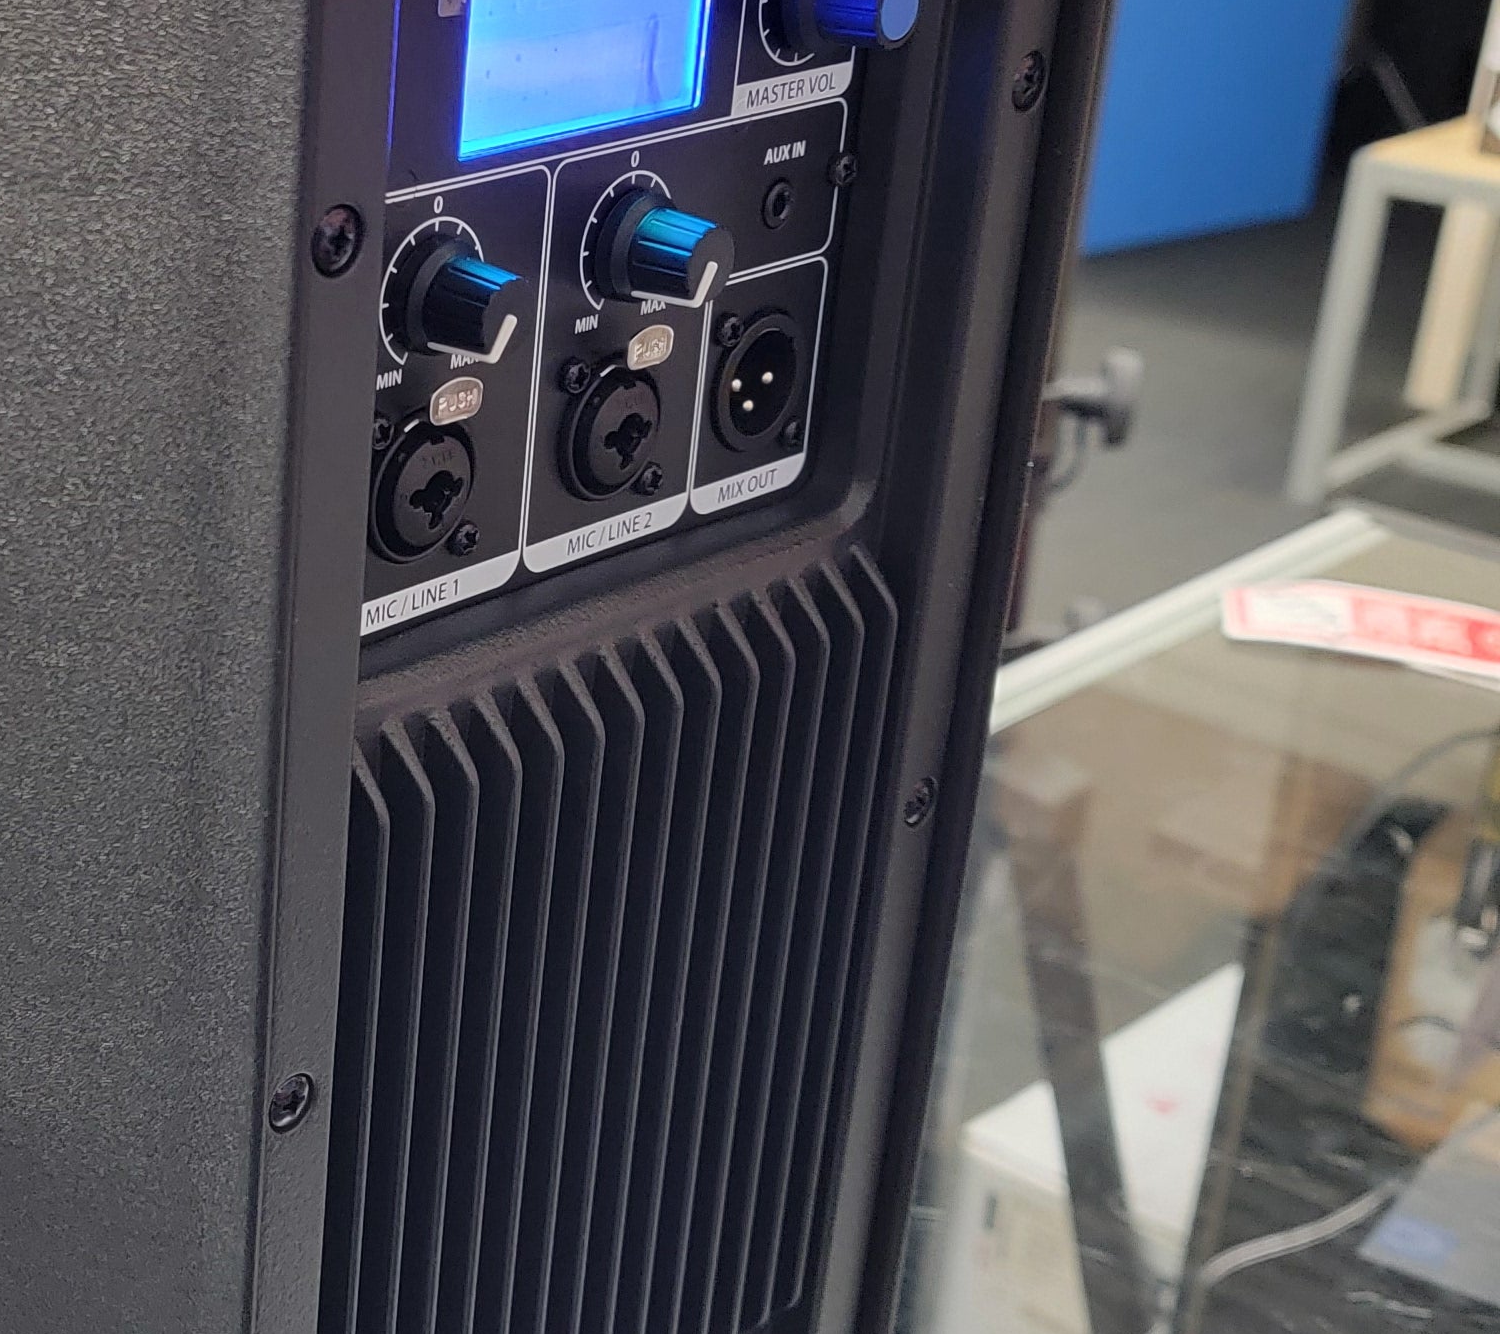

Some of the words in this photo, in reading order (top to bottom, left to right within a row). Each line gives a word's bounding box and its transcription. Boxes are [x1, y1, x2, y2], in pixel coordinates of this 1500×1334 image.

[746, 78, 806, 109] MASTER
[809, 71, 836, 95] VOL
[763, 143, 791, 166] AUX
[791, 139, 807, 159] IN
[574, 313, 599, 335] MIN
[376, 368, 403, 391] MIN
[436, 387, 479, 419] PUSH
[717, 482, 745, 504] MIX
[747, 468, 778, 493] OUT
[566, 529, 596, 556] MIC
[608, 516, 640, 542] LINE
[643, 511, 652, 528] 2
[365, 598, 397, 628] MIC
[411, 581, 448, 611] LINE
[452, 578, 459, 596] 1
